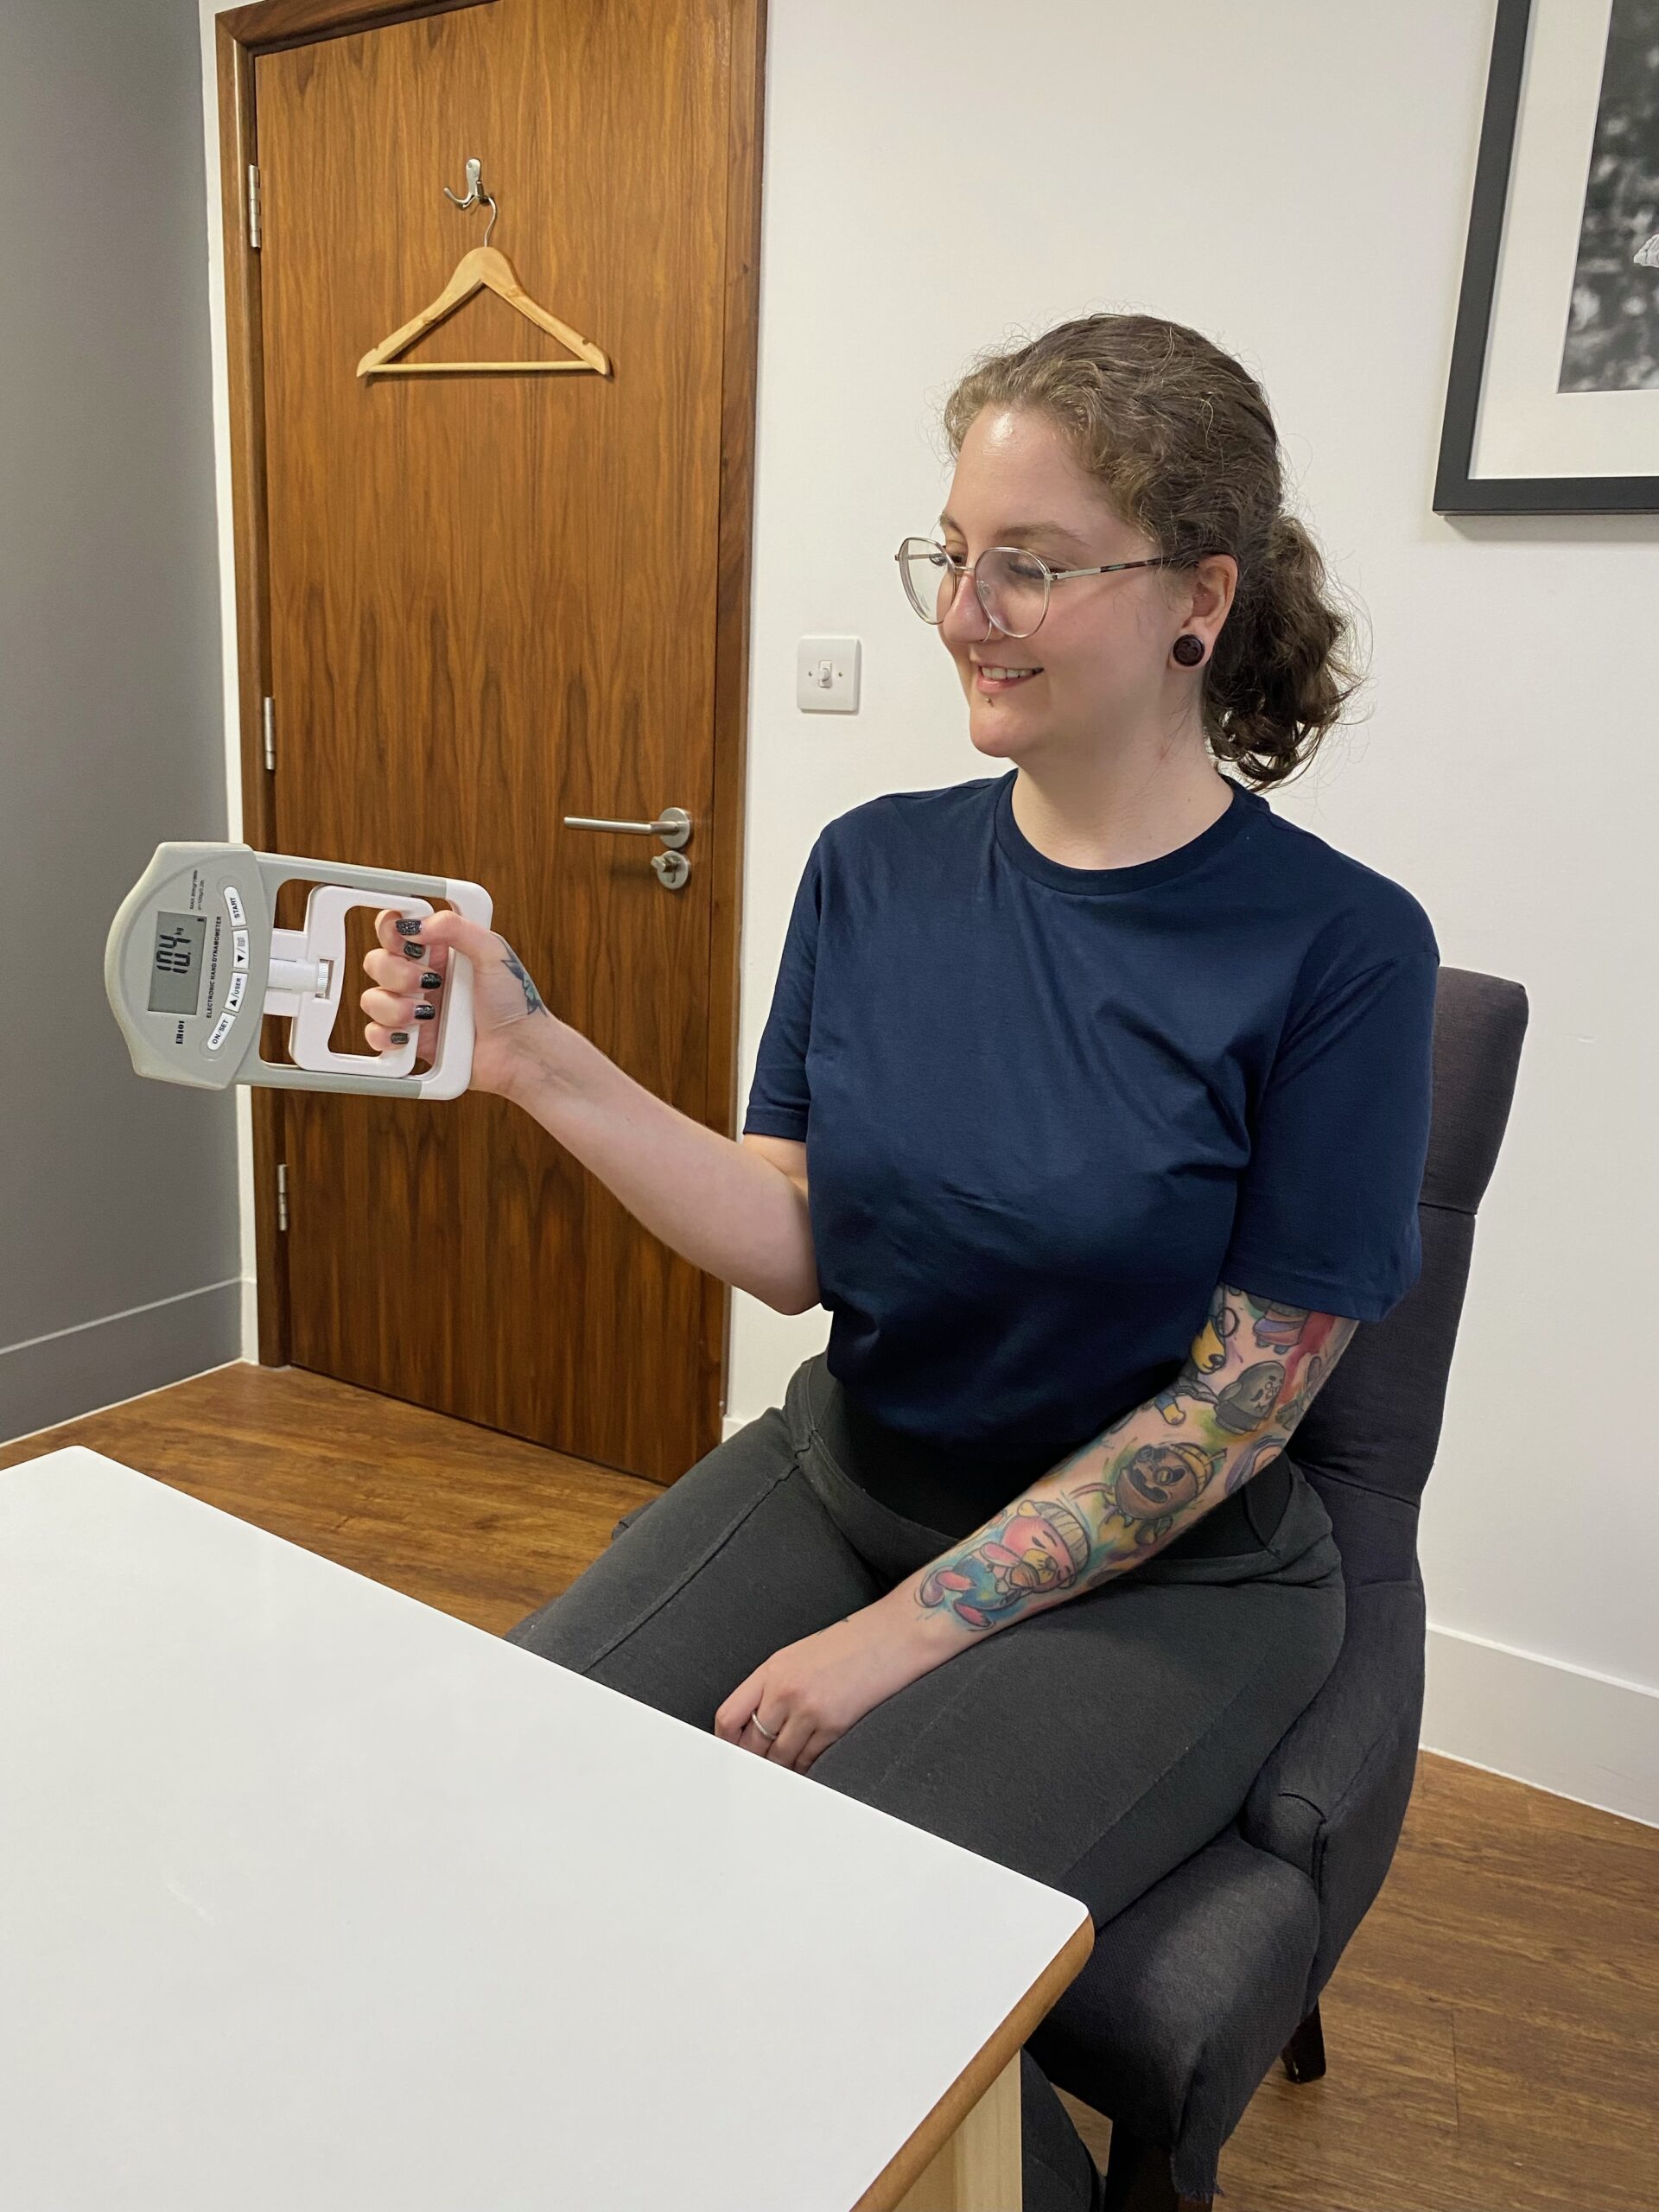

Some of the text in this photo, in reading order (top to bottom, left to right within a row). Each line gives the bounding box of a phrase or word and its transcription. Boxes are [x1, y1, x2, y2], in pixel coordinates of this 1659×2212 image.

[230, 897, 240, 918] START
[207, 980, 215, 1019] ELECTRONIC
[212, 916, 222, 963] DYNAMOMETER
[212, 1020, 229, 1045] ON/SET
